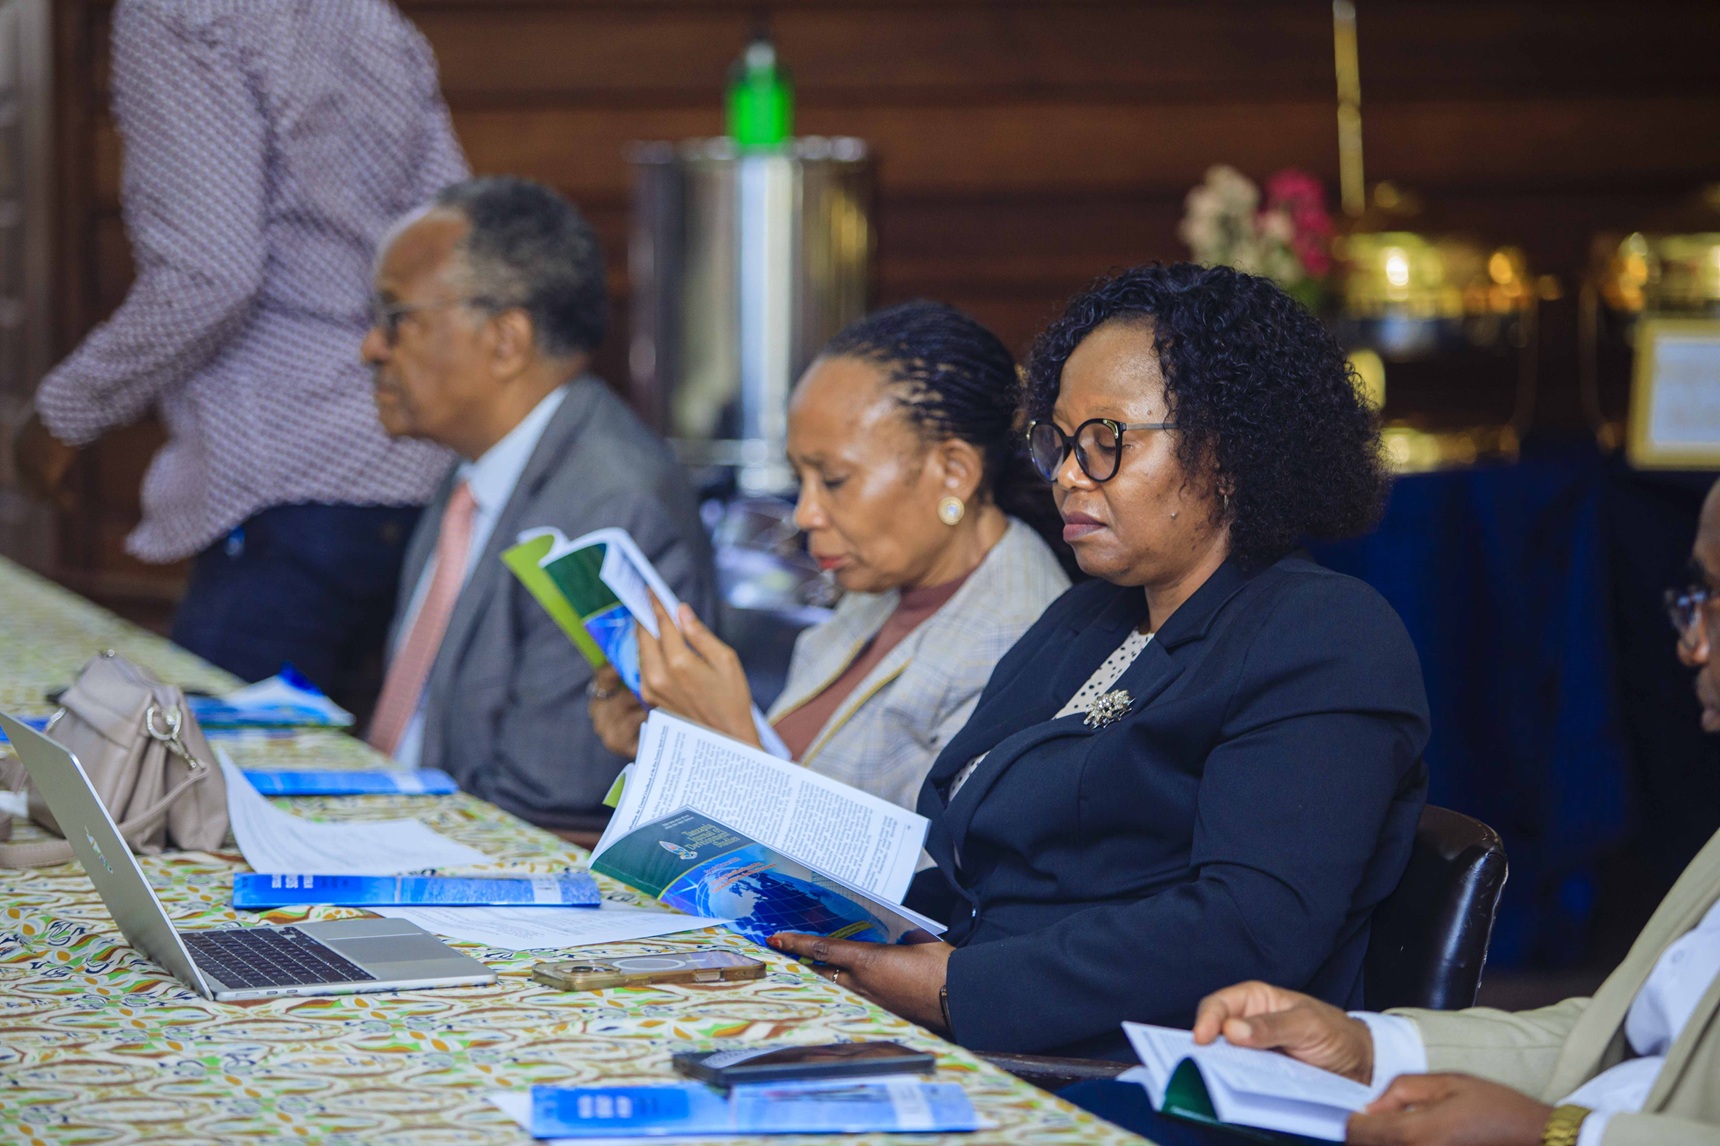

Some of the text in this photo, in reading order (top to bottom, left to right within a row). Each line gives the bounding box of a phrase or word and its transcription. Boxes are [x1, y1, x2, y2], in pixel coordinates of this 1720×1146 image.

[681, 824, 715, 837] Tanzania
[687, 829, 715, 843] Journal
[684, 832, 730, 850] Development
[712, 836, 740, 848] Studies
